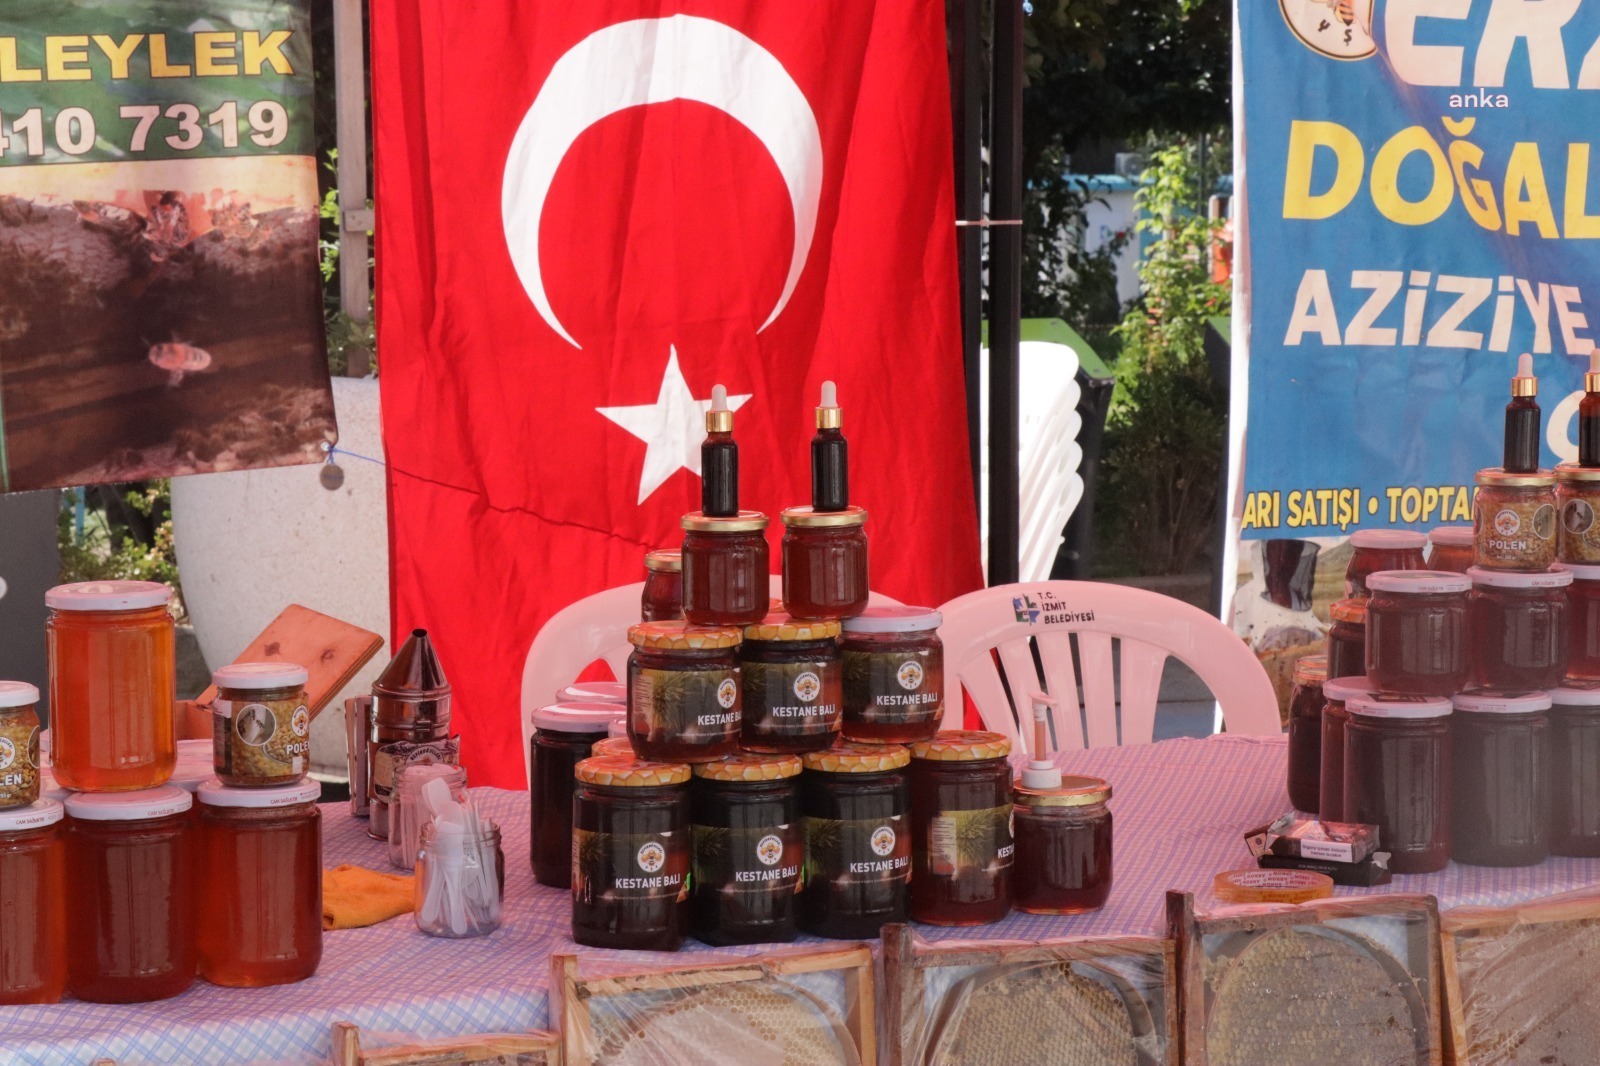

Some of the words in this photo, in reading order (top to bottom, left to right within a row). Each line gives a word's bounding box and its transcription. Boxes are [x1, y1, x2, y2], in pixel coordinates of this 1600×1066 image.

[1385, 0, 1600, 89] ER
[0, 30, 295, 82] LEYLEK
[0, 106, 96, 157] 10
[118, 100, 289, 151] 7319
[1282, 116, 1600, 240] DOĞAL
[1242, 491, 1280, 530] ARI
[1287, 487, 1360, 531] SATIŞI
[1386, 485, 1477, 524] TOPTA
[1489, 540, 1527, 550] POLEN
[1037, 591, 1057, 600] T.C.
[1041, 600, 1066, 612] İZMİT
[1044, 609, 1095, 624] BELEDİYESİ
[876, 694, 921, 706] KESTANE
[772, 706, 818, 717] KESTANE
[819, 704, 836, 716] BALI
[697, 712, 735, 726] KESTANE
[286, 740, 310, 755] POLE
[735, 868, 781, 882] KESTANE
[782, 865, 798, 878] BALI
[850, 859, 894, 873] KESTANE
[615, 876, 662, 889] KESTANE
[663, 873, 681, 887] BALI
